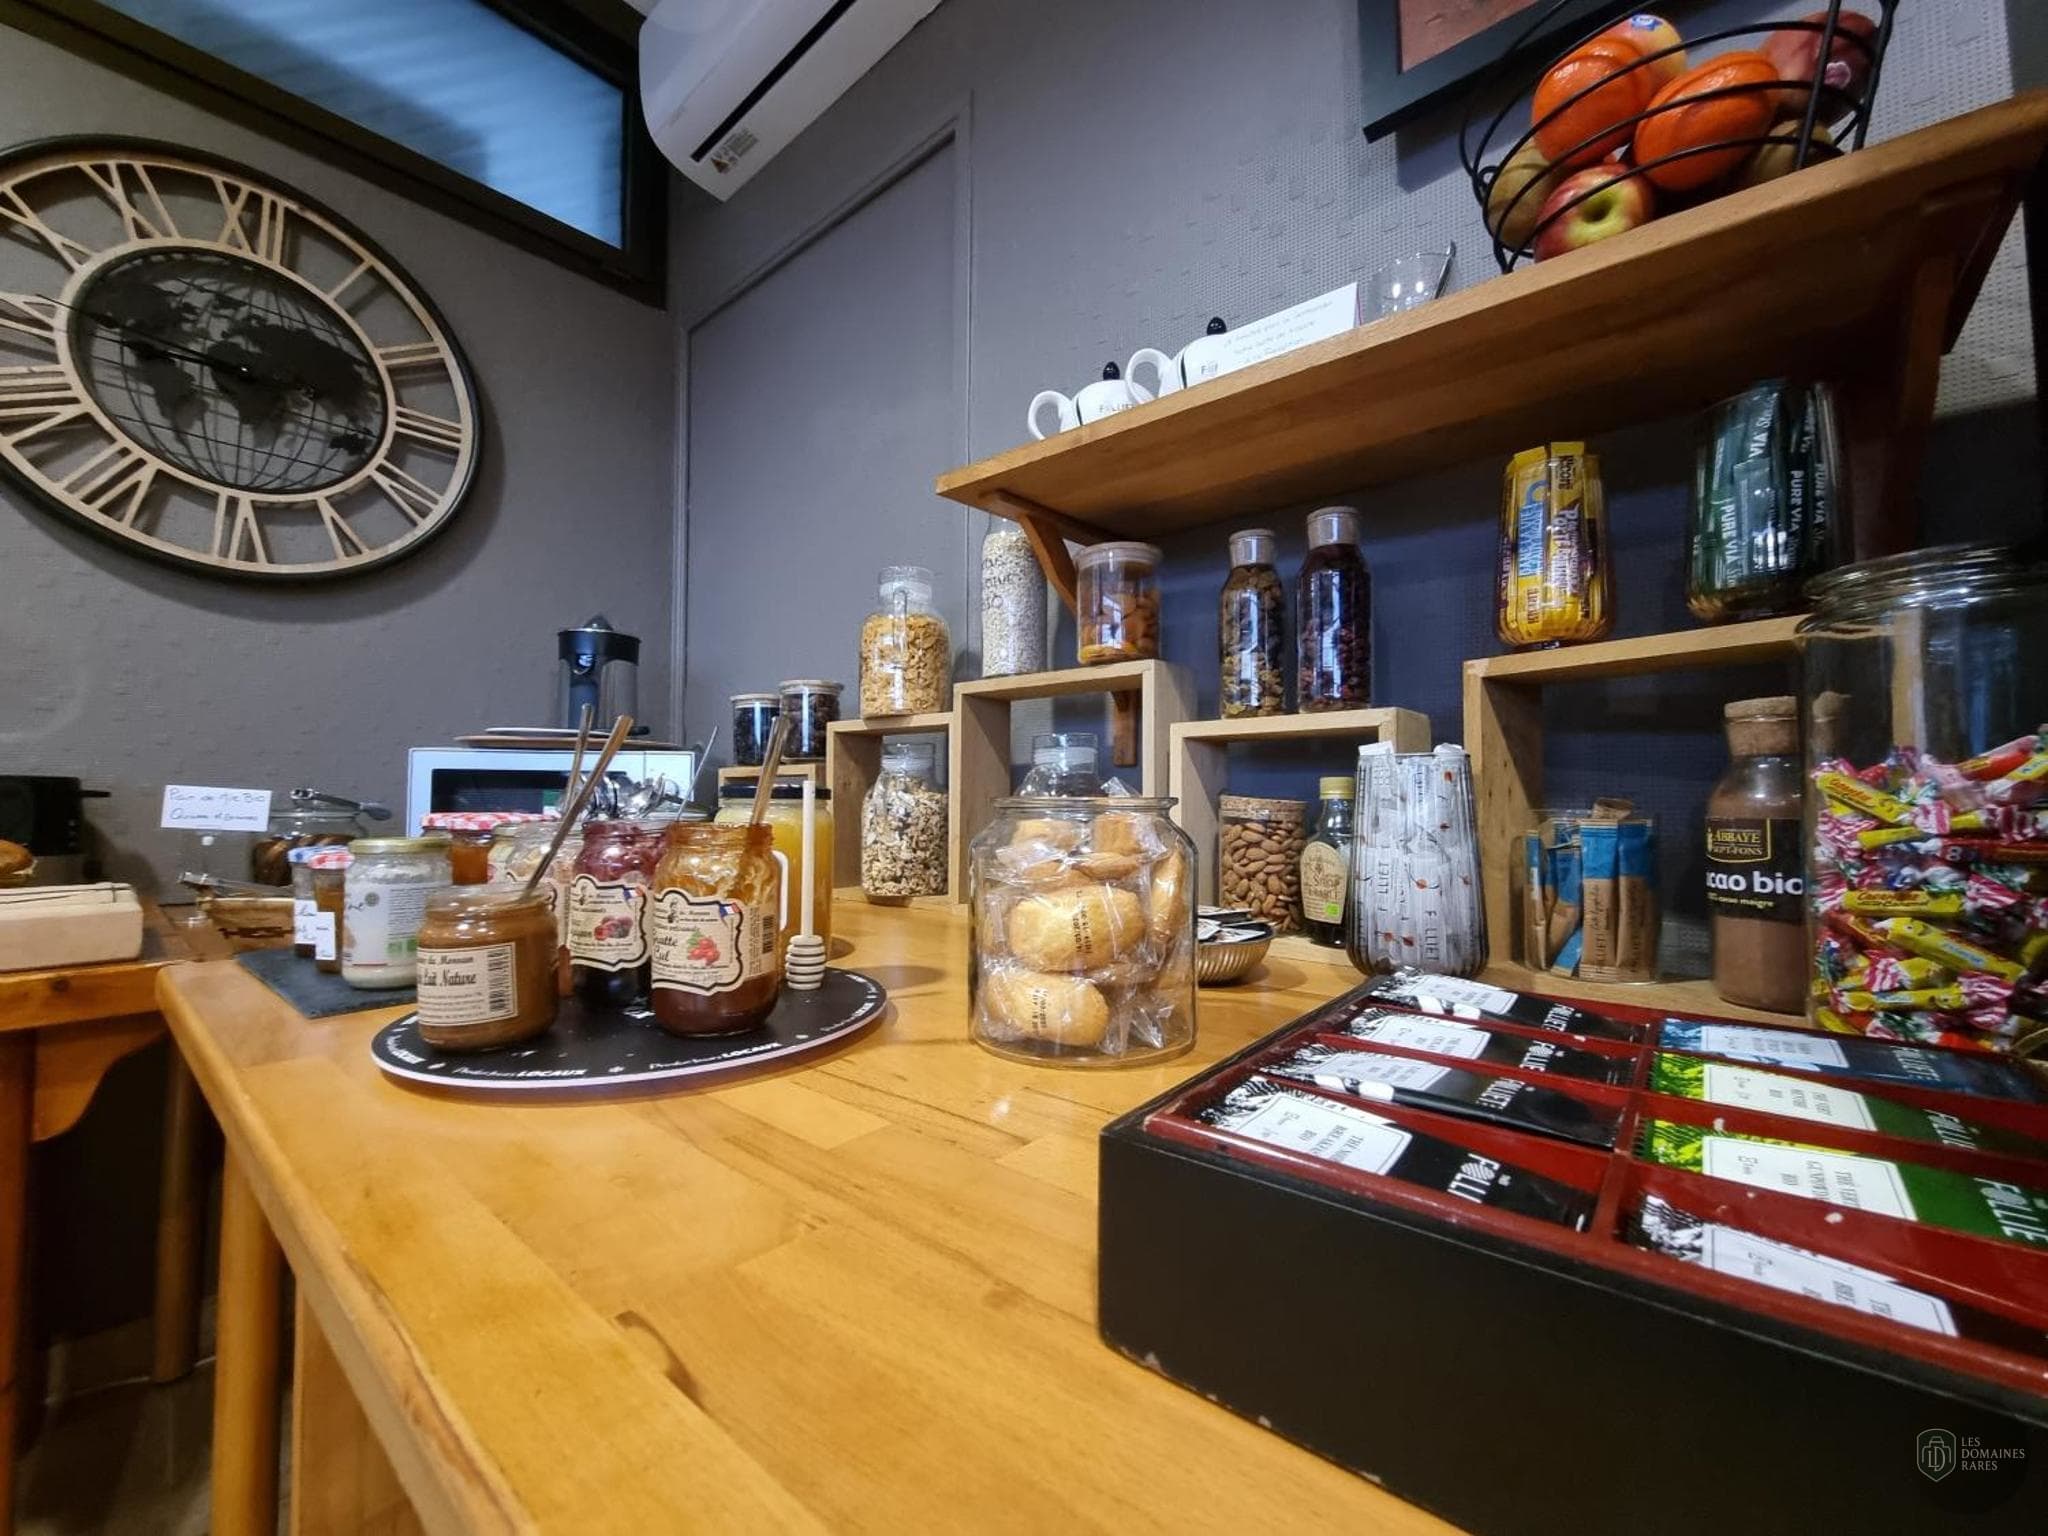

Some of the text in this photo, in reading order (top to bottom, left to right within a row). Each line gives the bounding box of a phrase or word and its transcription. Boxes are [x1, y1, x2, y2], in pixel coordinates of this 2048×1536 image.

[209, 173, 287, 268] XII
[374, 340, 445, 366] II
[394, 403, 463, 449] III
[57, 441, 157, 530] VII
[1790, 470, 1805, 505] PURE
[213, 488, 268, 566] VI
[315, 497, 370, 558] V
[1721, 504, 1738, 539] PURE
[1789, 508, 1804, 532] VIA
[1724, 541, 1738, 562] VIA
[1713, 831, 1761, 843] ABBAYE
[1752, 870, 1803, 895] bio
[440, 967, 477, 987] Nature
[1446, 1152, 1502, 1204] FOLLI
[1974, 1176, 2048, 1244] FOLLIE
